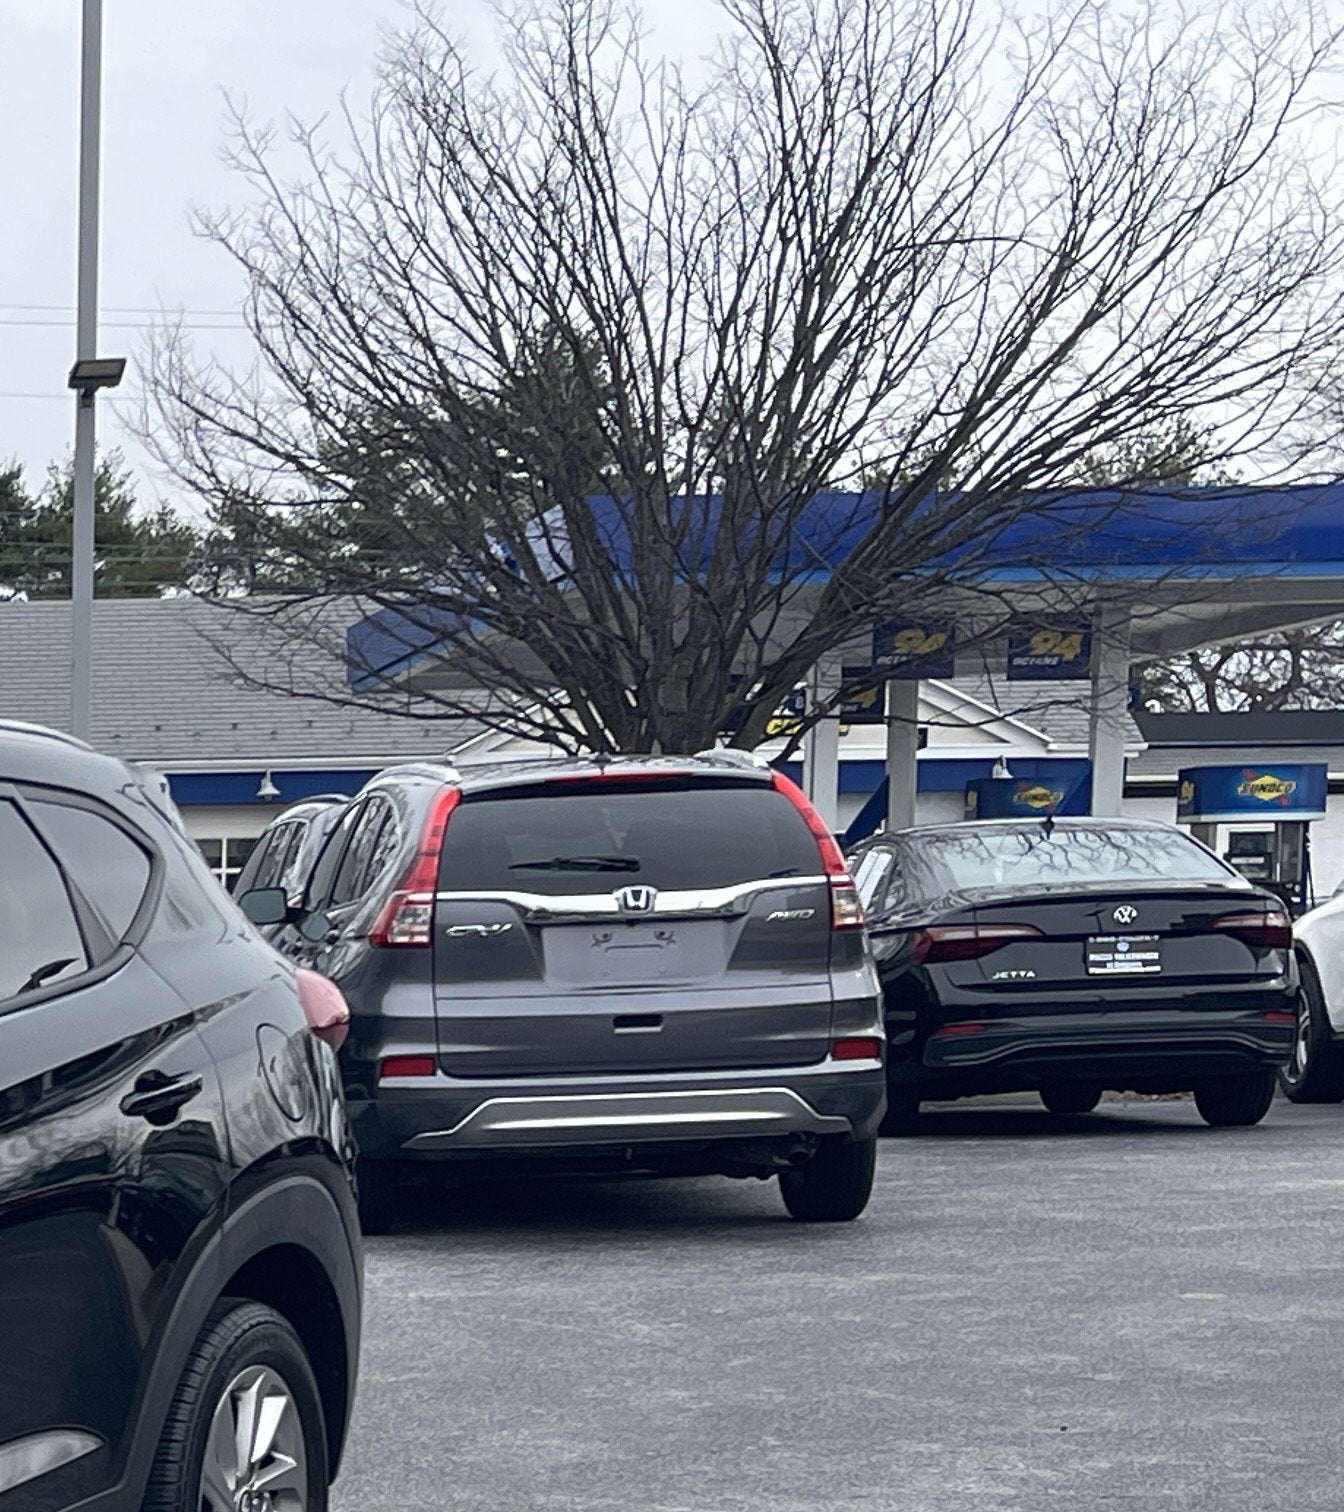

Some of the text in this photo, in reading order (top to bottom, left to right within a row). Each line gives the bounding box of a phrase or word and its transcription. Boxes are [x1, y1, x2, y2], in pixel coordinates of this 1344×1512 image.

[1029, 630, 1083, 661] 94
[1241, 782, 1294, 794] SUNOCO
[992, 970, 1036, 979] JETTA
